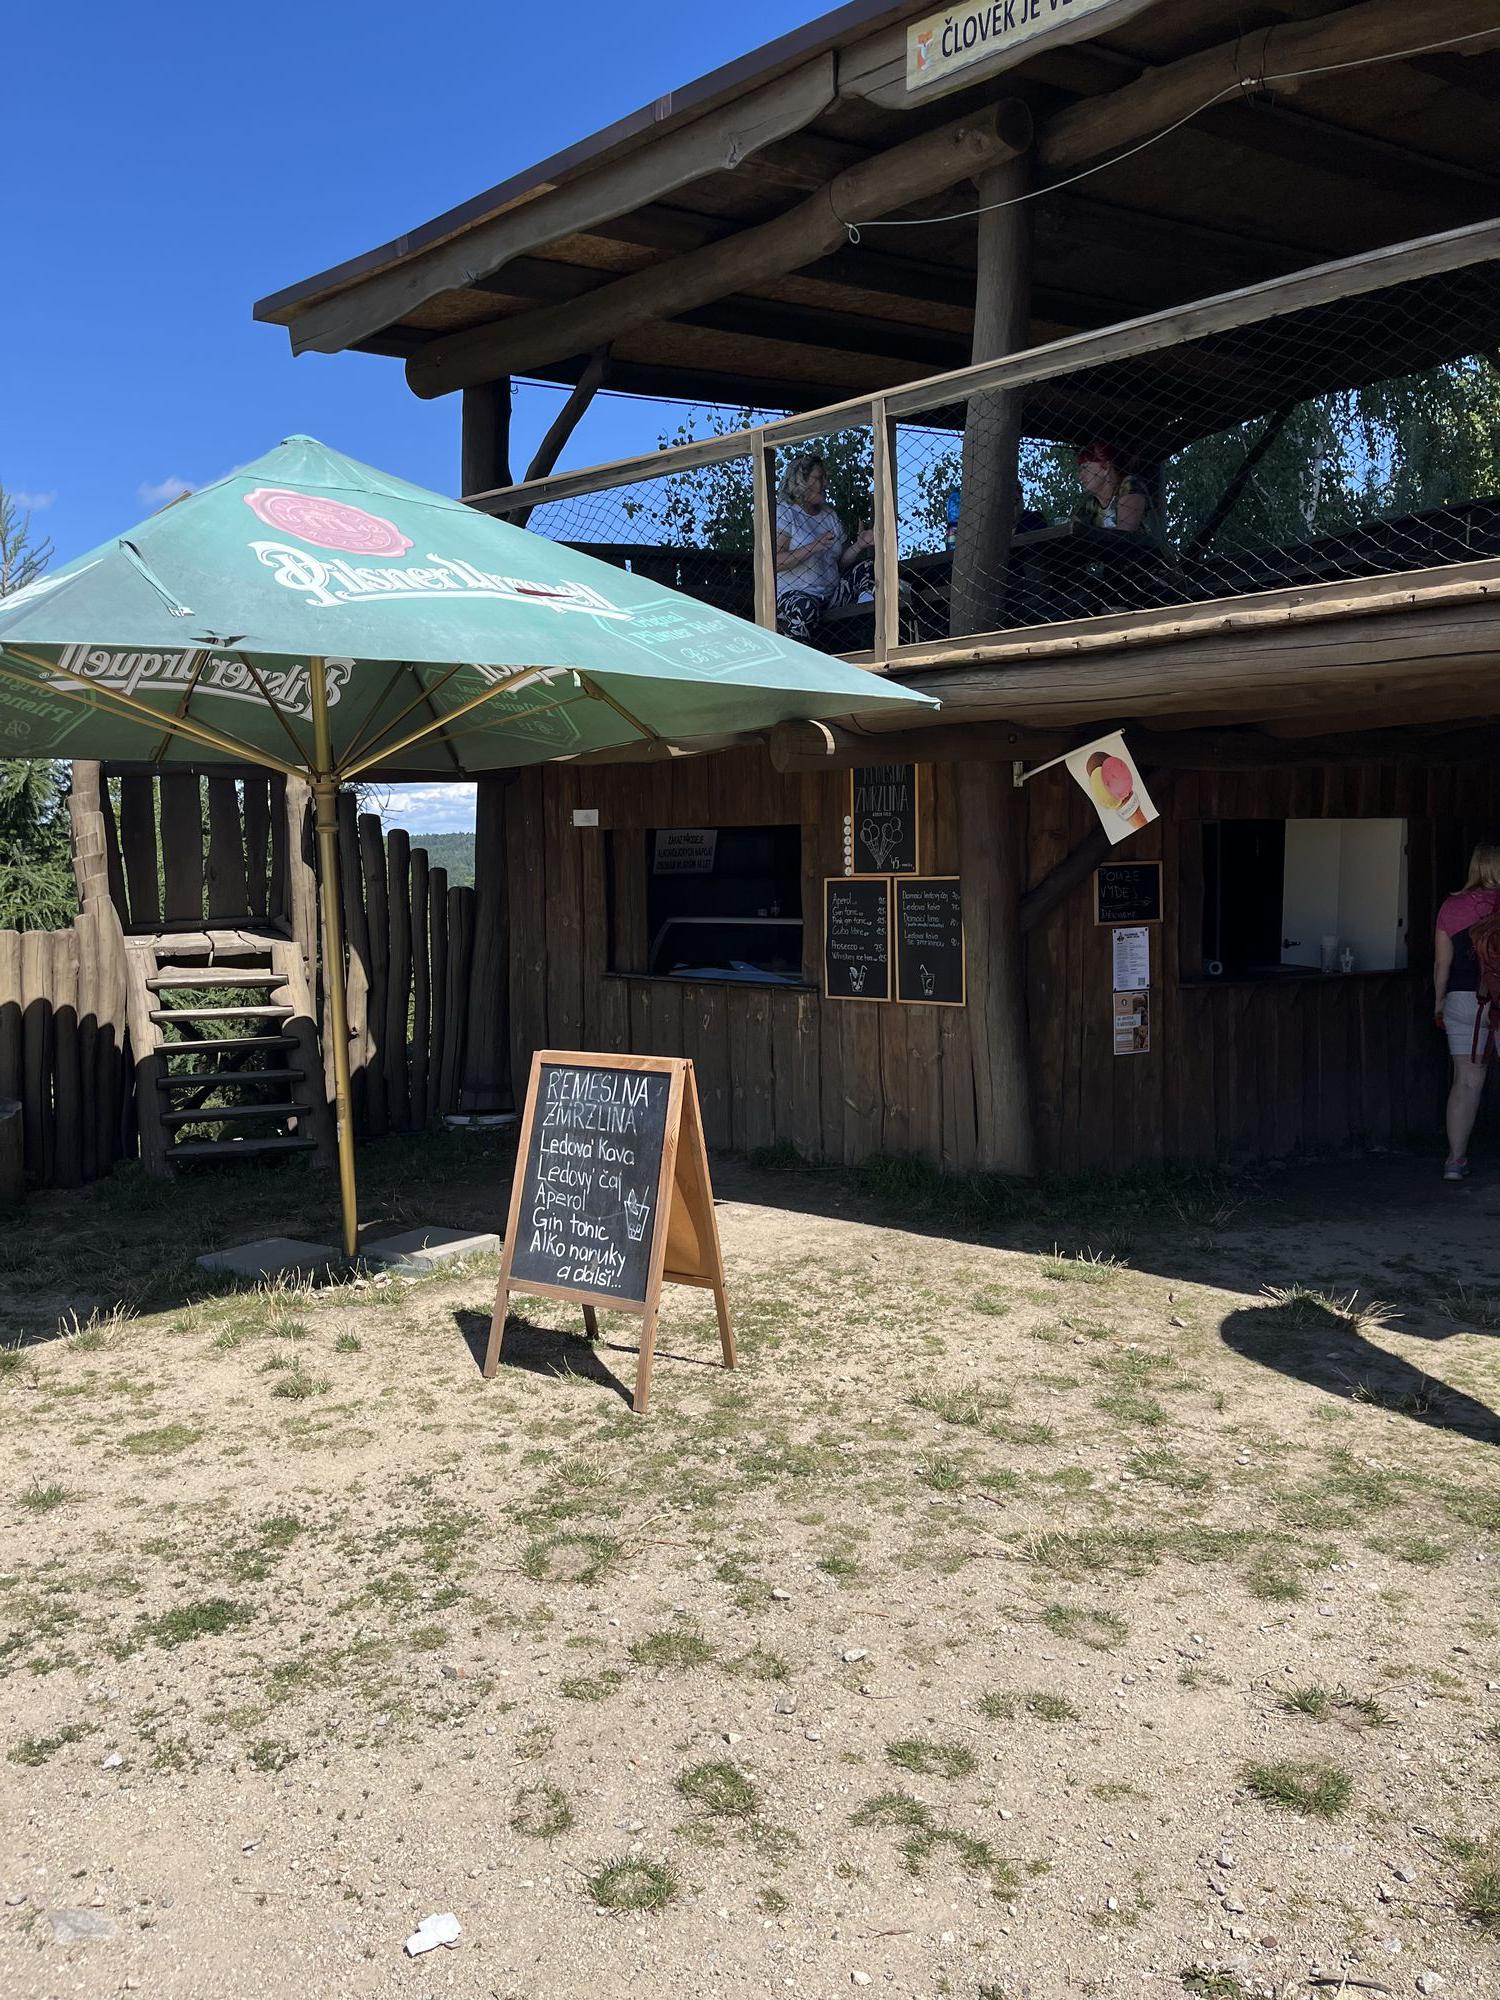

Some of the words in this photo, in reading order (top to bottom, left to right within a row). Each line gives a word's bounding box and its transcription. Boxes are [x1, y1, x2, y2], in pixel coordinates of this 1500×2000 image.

[248, 541, 463, 607] Pilsner
[831, 940, 858, 951] Prosecco
[540, 1129, 594, 1159] Ledová
[537, 1153, 595, 1194] Ledový
[599, 1169, 623, 1202] čaj
[535, 1181, 587, 1211] Aperol
[532, 1207, 563, 1232] Gin
[569, 1213, 610, 1242] tonic
[557, 1265, 570, 1279] a
[569, 1242, 626, 1278] naruky
